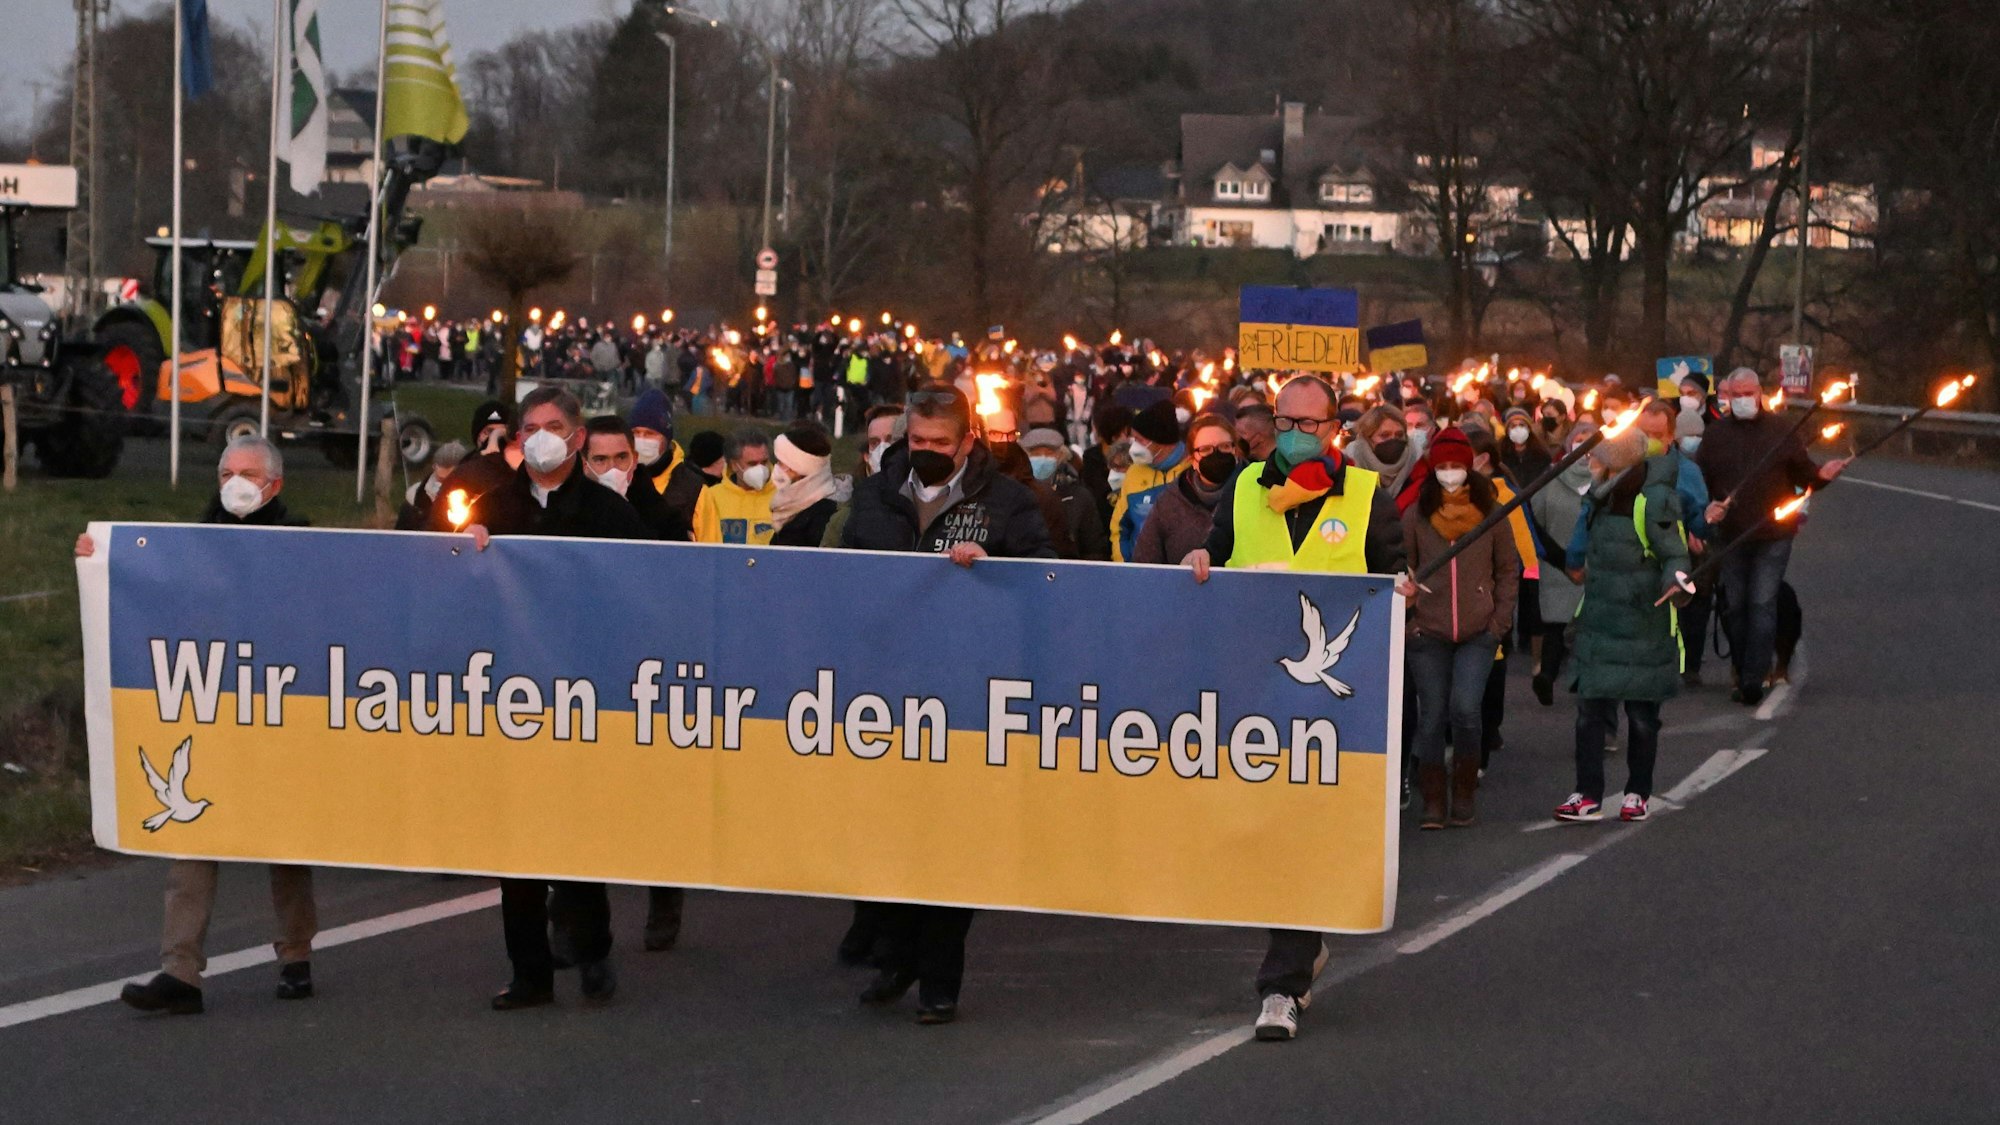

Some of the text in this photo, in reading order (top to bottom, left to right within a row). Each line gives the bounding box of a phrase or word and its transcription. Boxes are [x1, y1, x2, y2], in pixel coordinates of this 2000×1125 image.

[0, 176, 18, 194] H
[947, 526, 989, 542] DAVID
[149, 638, 1339, 786] Wir laufen für den Frieden
